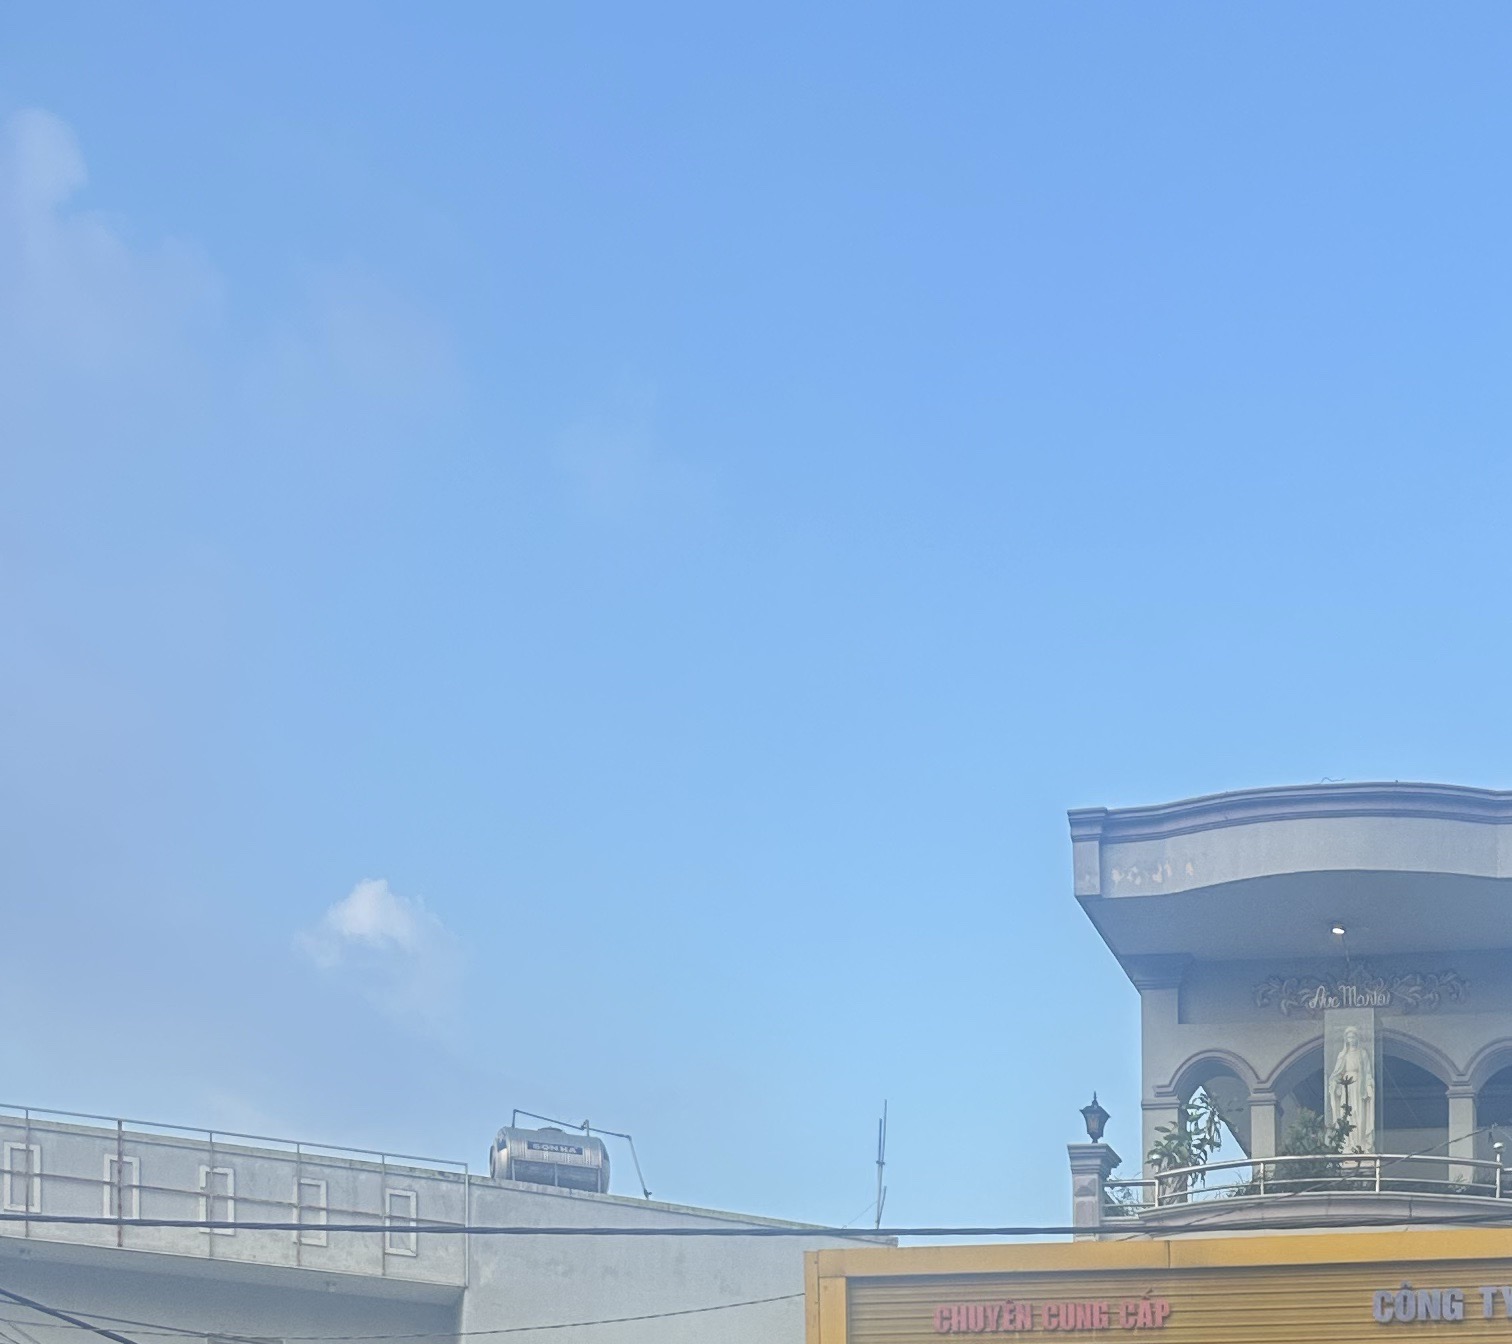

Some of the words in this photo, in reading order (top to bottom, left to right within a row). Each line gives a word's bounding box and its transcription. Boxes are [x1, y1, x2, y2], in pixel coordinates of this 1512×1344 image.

[934, 1300, 1033, 1333] CHUYÊN
[1041, 1302, 1111, 1331] CUNG
[1119, 1288, 1172, 1330] CẤP
[1373, 1281, 1464, 1323] CÔNG
